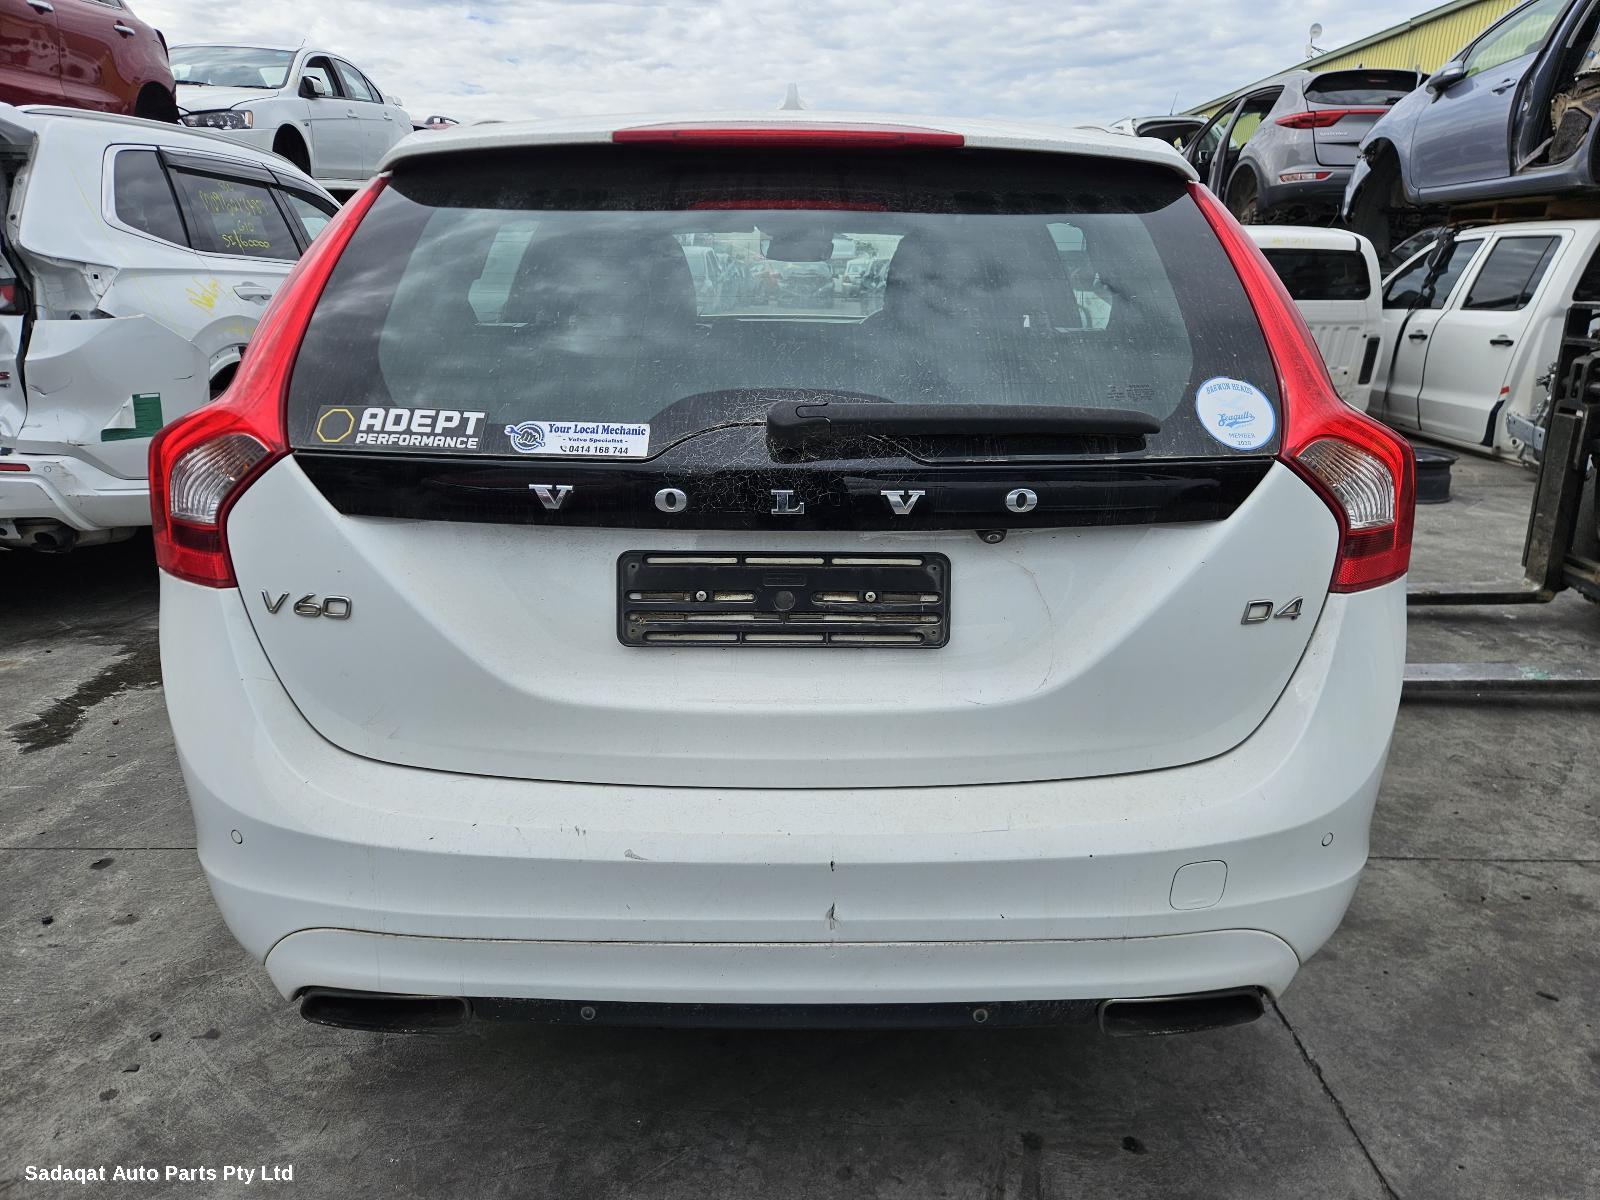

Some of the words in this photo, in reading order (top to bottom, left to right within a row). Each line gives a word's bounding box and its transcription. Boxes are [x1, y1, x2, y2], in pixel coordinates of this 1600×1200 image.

[359, 407, 486, 435] ADEPT
[548, 423, 572, 433] Your
[573, 424, 599, 434] Local
[601, 424, 646, 436] Mechanic
[355, 433, 479, 449] PERFORMANCE
[568, 445, 590, 453] 0414
[594, 446, 609, 454] 168
[612, 446, 629, 454] 744
[528, 483, 1038, 516] VOLVO
[260, 587, 352, 620] V60
[1240, 596, 1303, 625] D4
